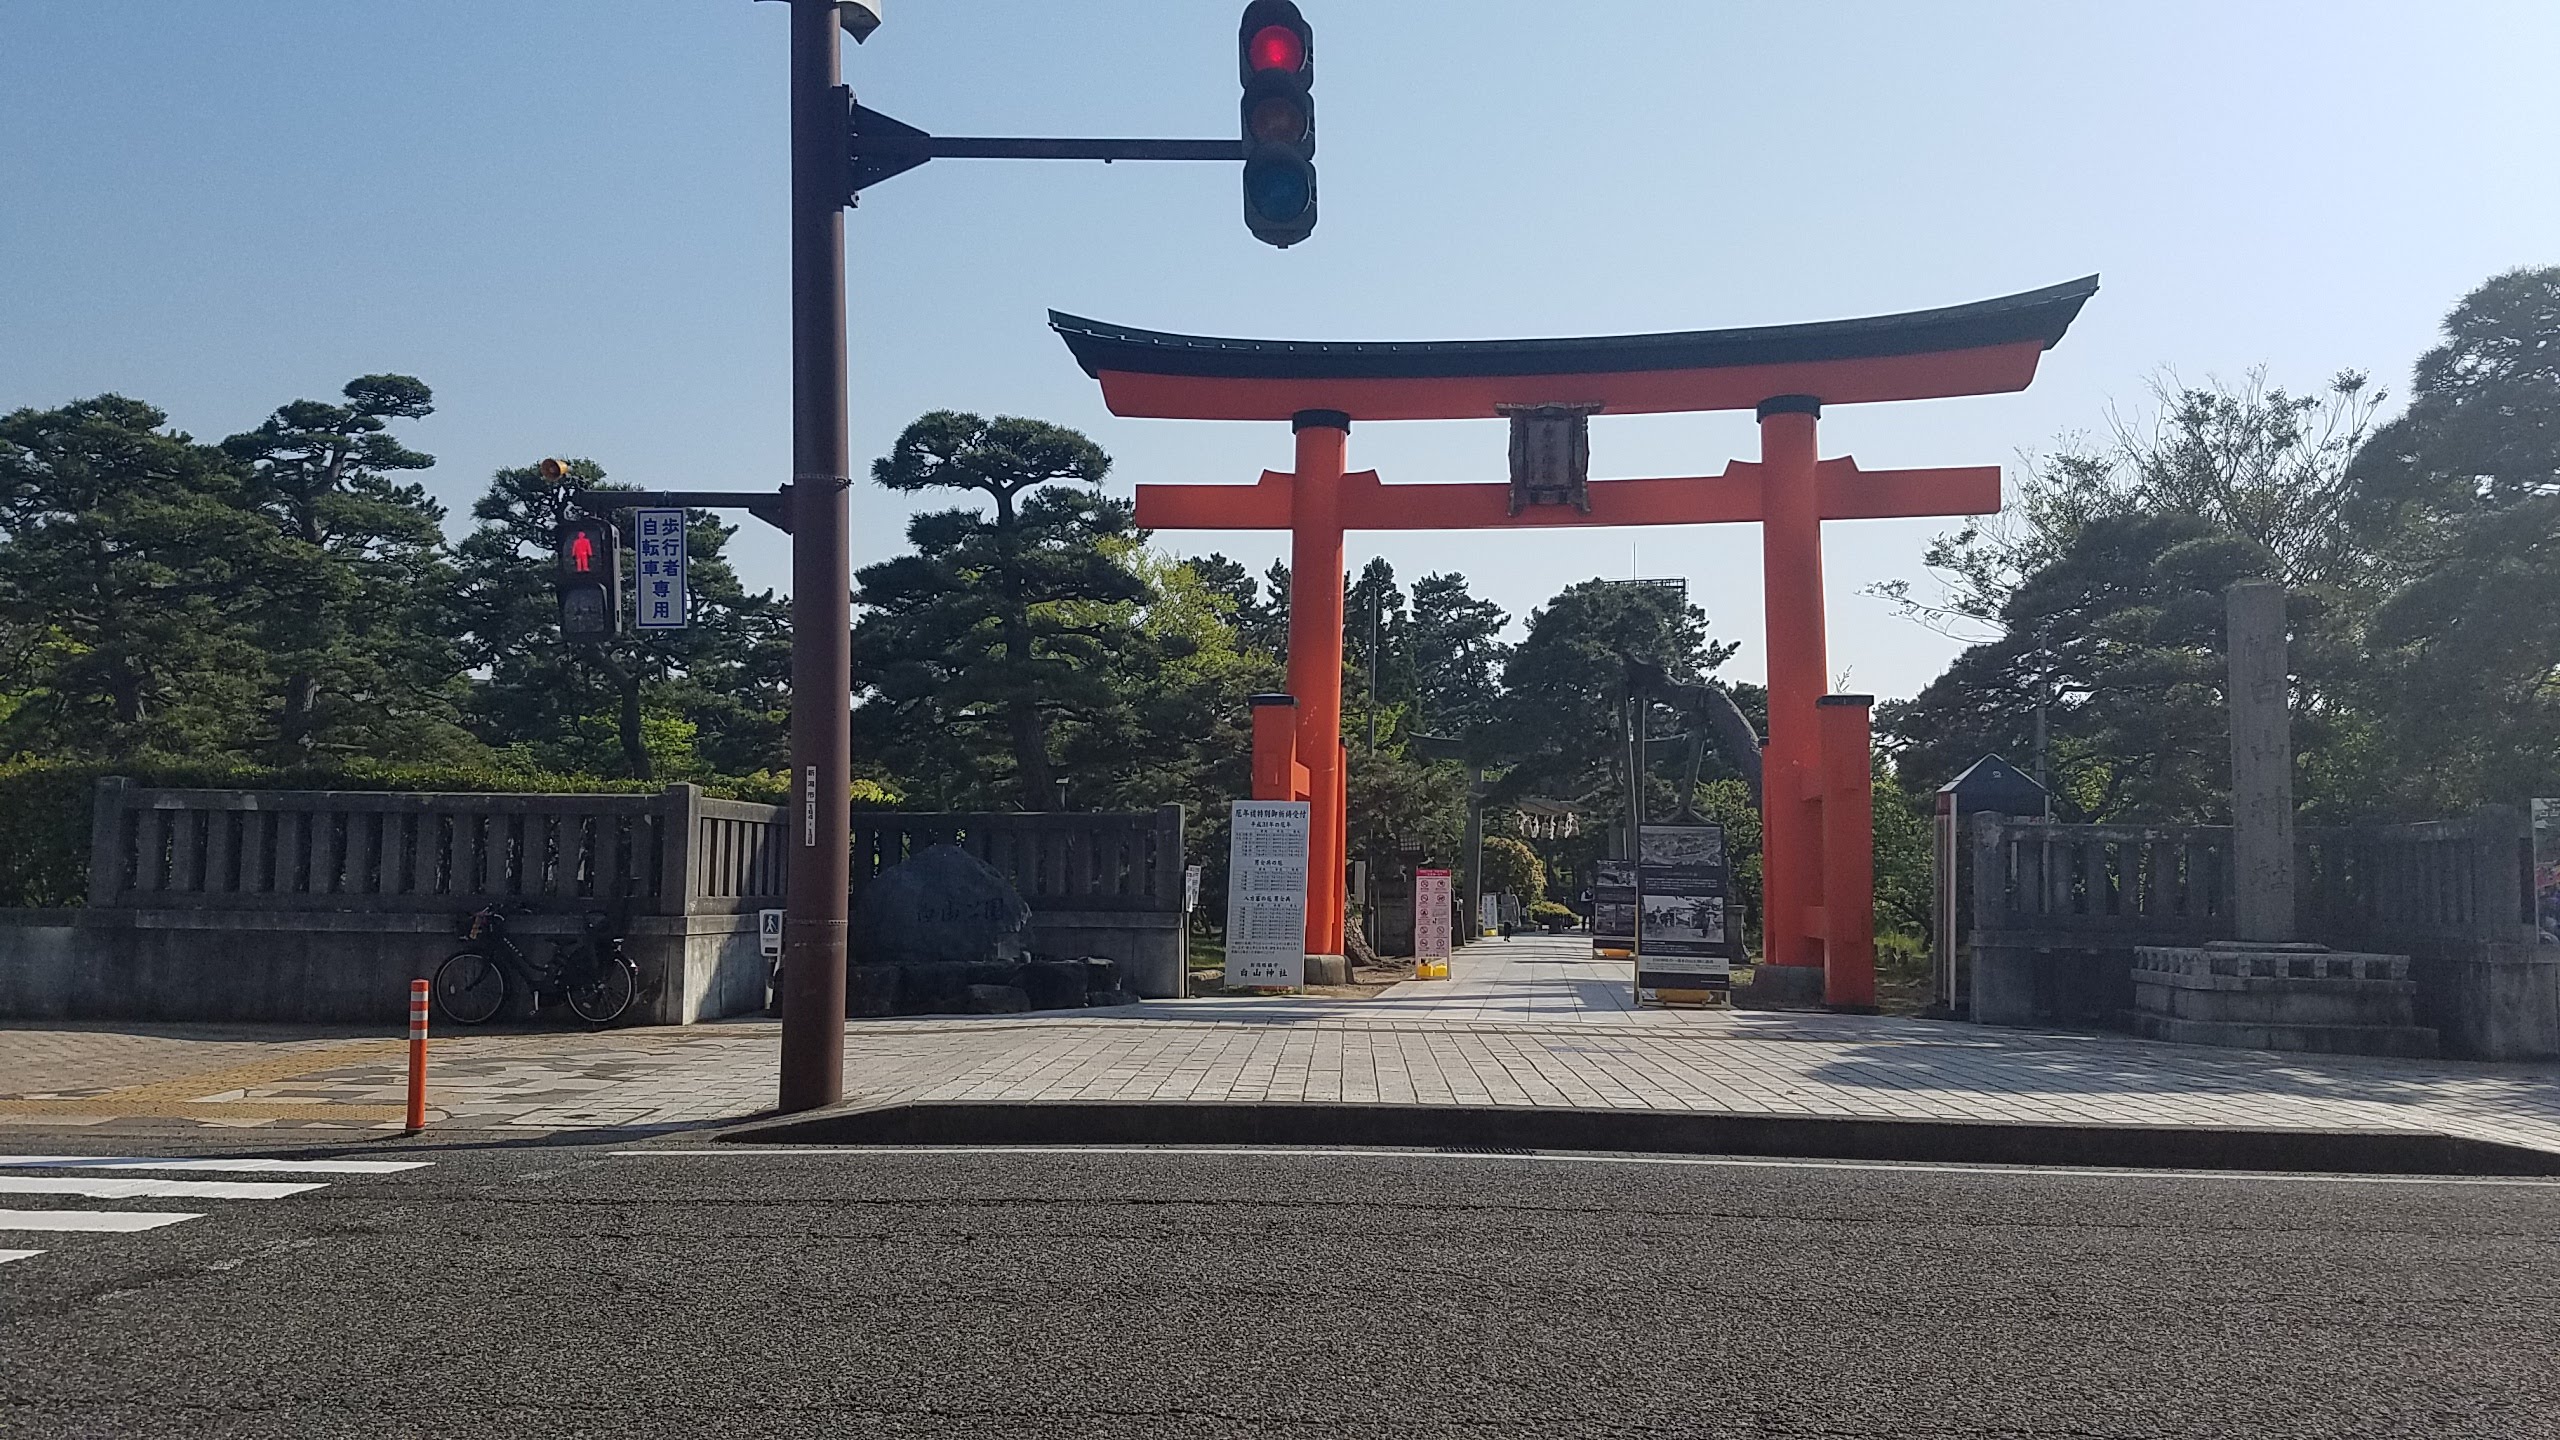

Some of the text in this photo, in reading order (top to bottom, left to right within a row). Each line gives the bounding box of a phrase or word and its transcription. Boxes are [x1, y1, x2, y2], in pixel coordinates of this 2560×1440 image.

[642, 518, 659, 577] 自転車
[662, 518, 679, 577] 歩行者
[652, 580, 670, 619] 専用
[1240, 968, 1288, 978] 白山神社
